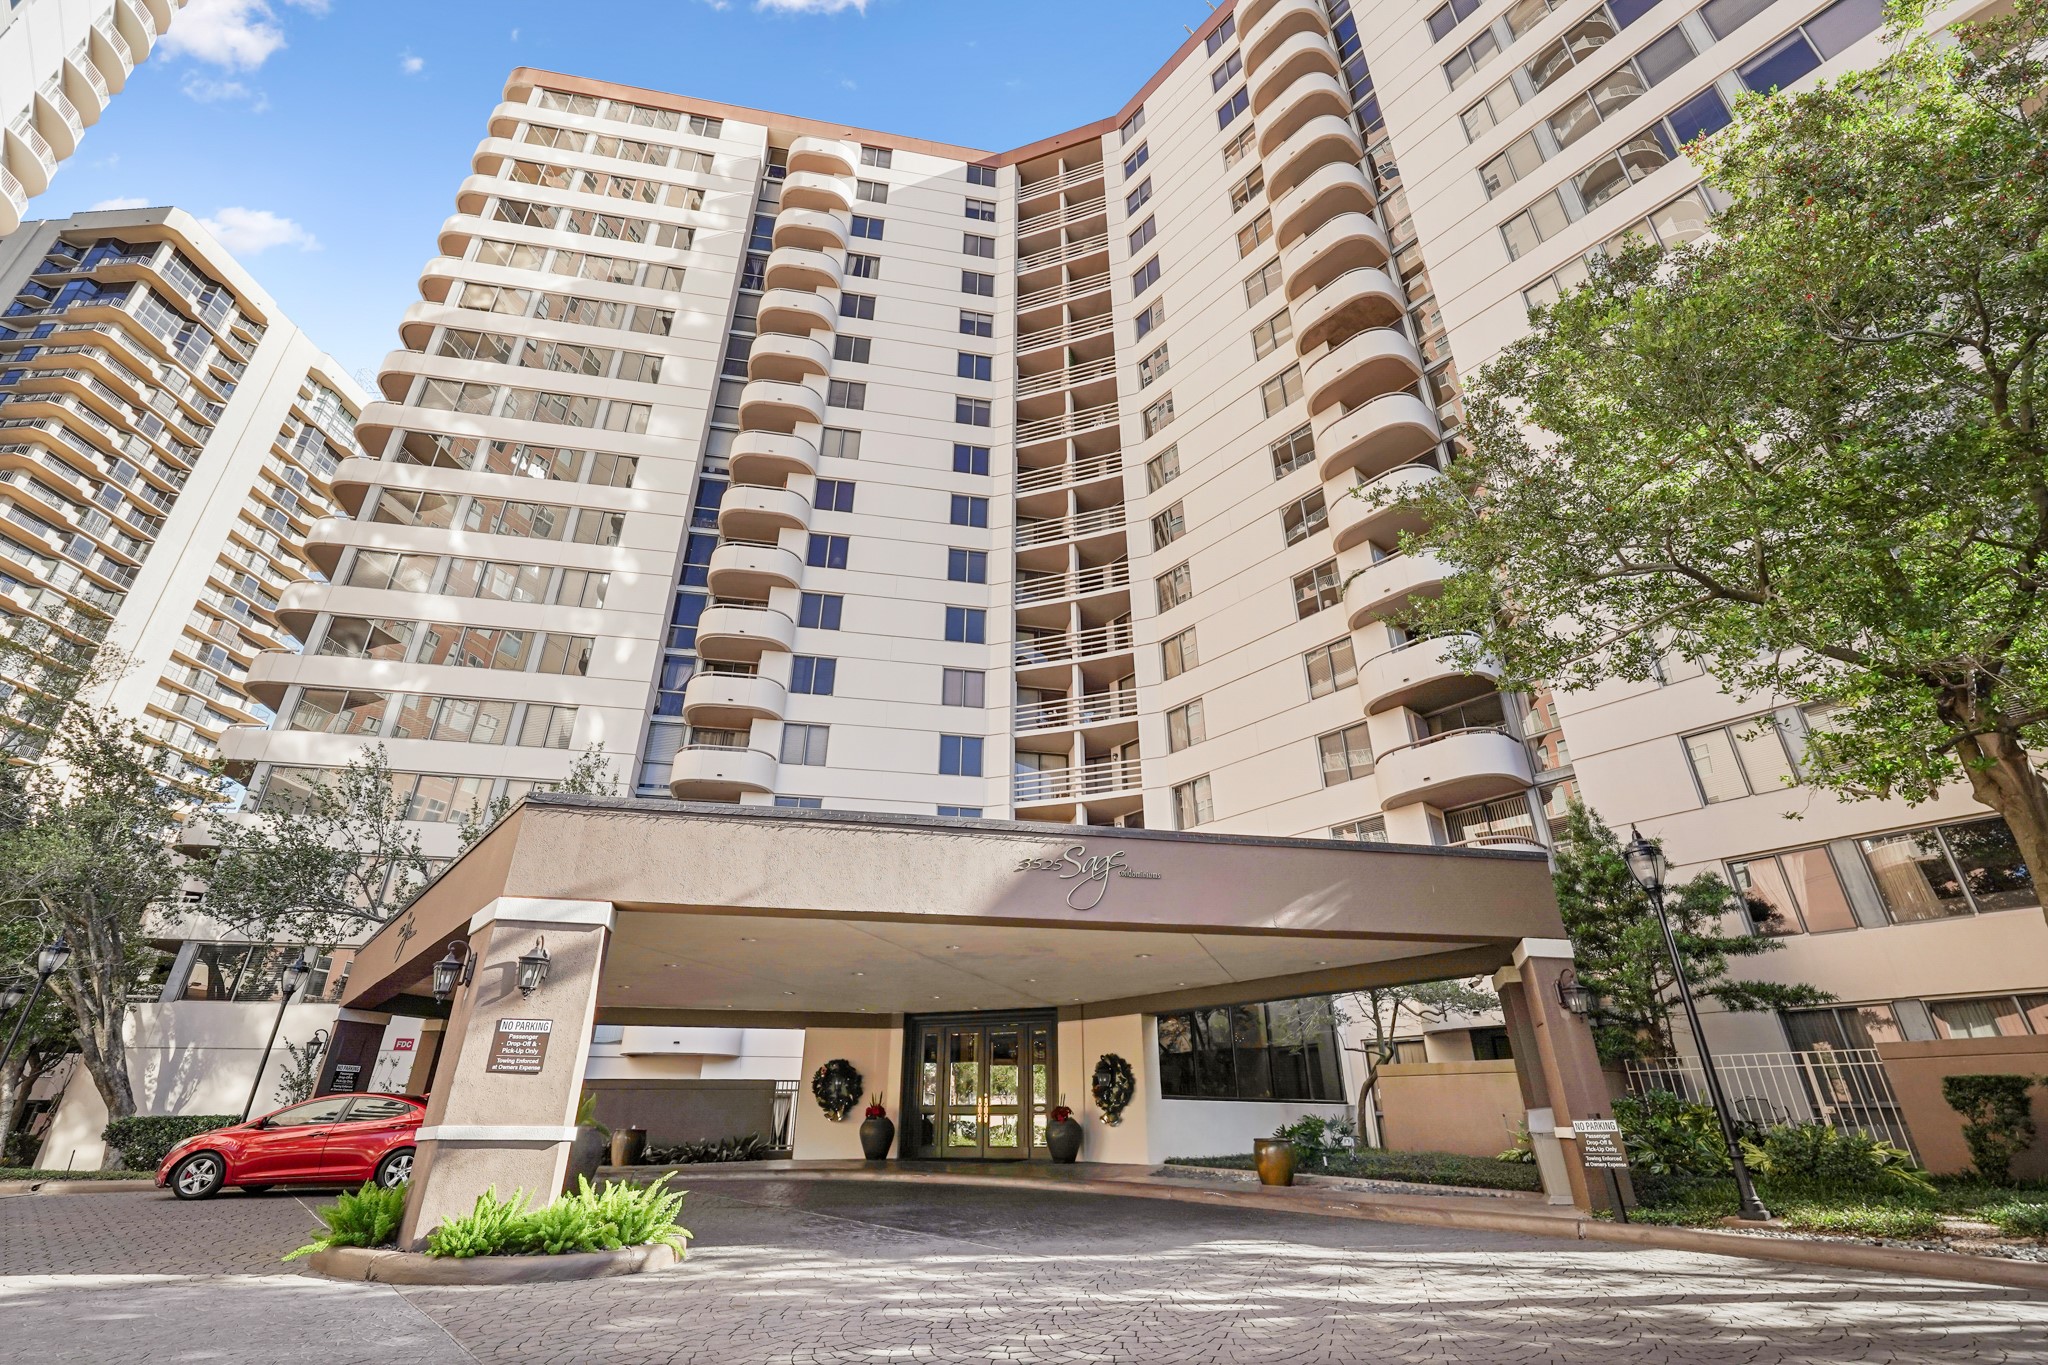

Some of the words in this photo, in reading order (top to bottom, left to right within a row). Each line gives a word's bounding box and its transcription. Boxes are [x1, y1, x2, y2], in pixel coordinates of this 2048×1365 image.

[1017, 858, 1064, 871] 3525
[1059, 845, 1128, 910] Sage
[1118, 869, 1161, 879] condominiums
[501, 1021, 513, 1030] NO
[515, 1021, 549, 1031] PARKING
[1575, 1122, 1585, 1131] NO
[1585, 1121, 1616, 1130] PARKING
